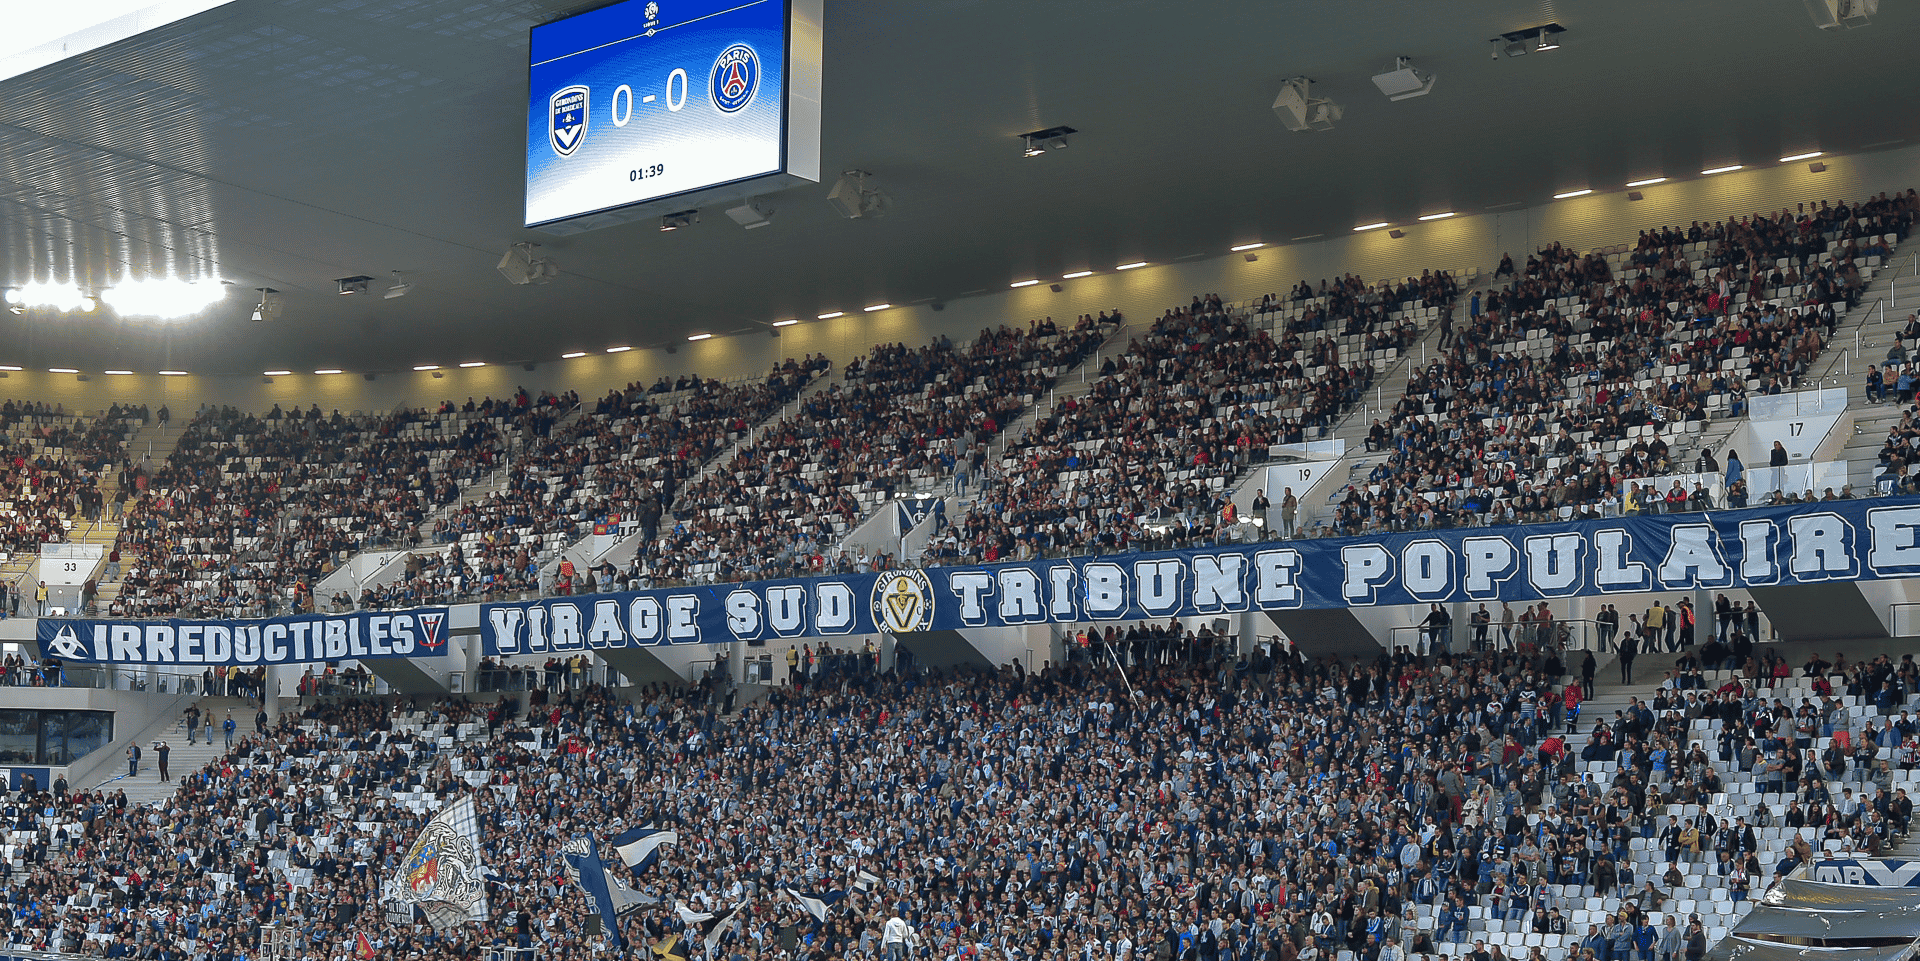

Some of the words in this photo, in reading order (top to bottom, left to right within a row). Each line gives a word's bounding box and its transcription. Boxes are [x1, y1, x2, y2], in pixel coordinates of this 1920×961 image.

[720, 50, 750, 69] PARIS
[612, 85, 633, 127] 0
[666, 68, 687, 112] 0
[630, 163, 664, 181] 01:39
[1789, 422, 1803, 436] 17
[1299, 469, 1311, 481] 19
[64, 562, 77, 572] 33
[950, 548, 1303, 627] TRIBUNE
[1341, 505, 1920, 606] POPULAIRE
[489, 594, 701, 655] VIRAGE
[725, 582, 857, 641] SUD
[94, 614, 415, 664] IRREDUCTIBLES
